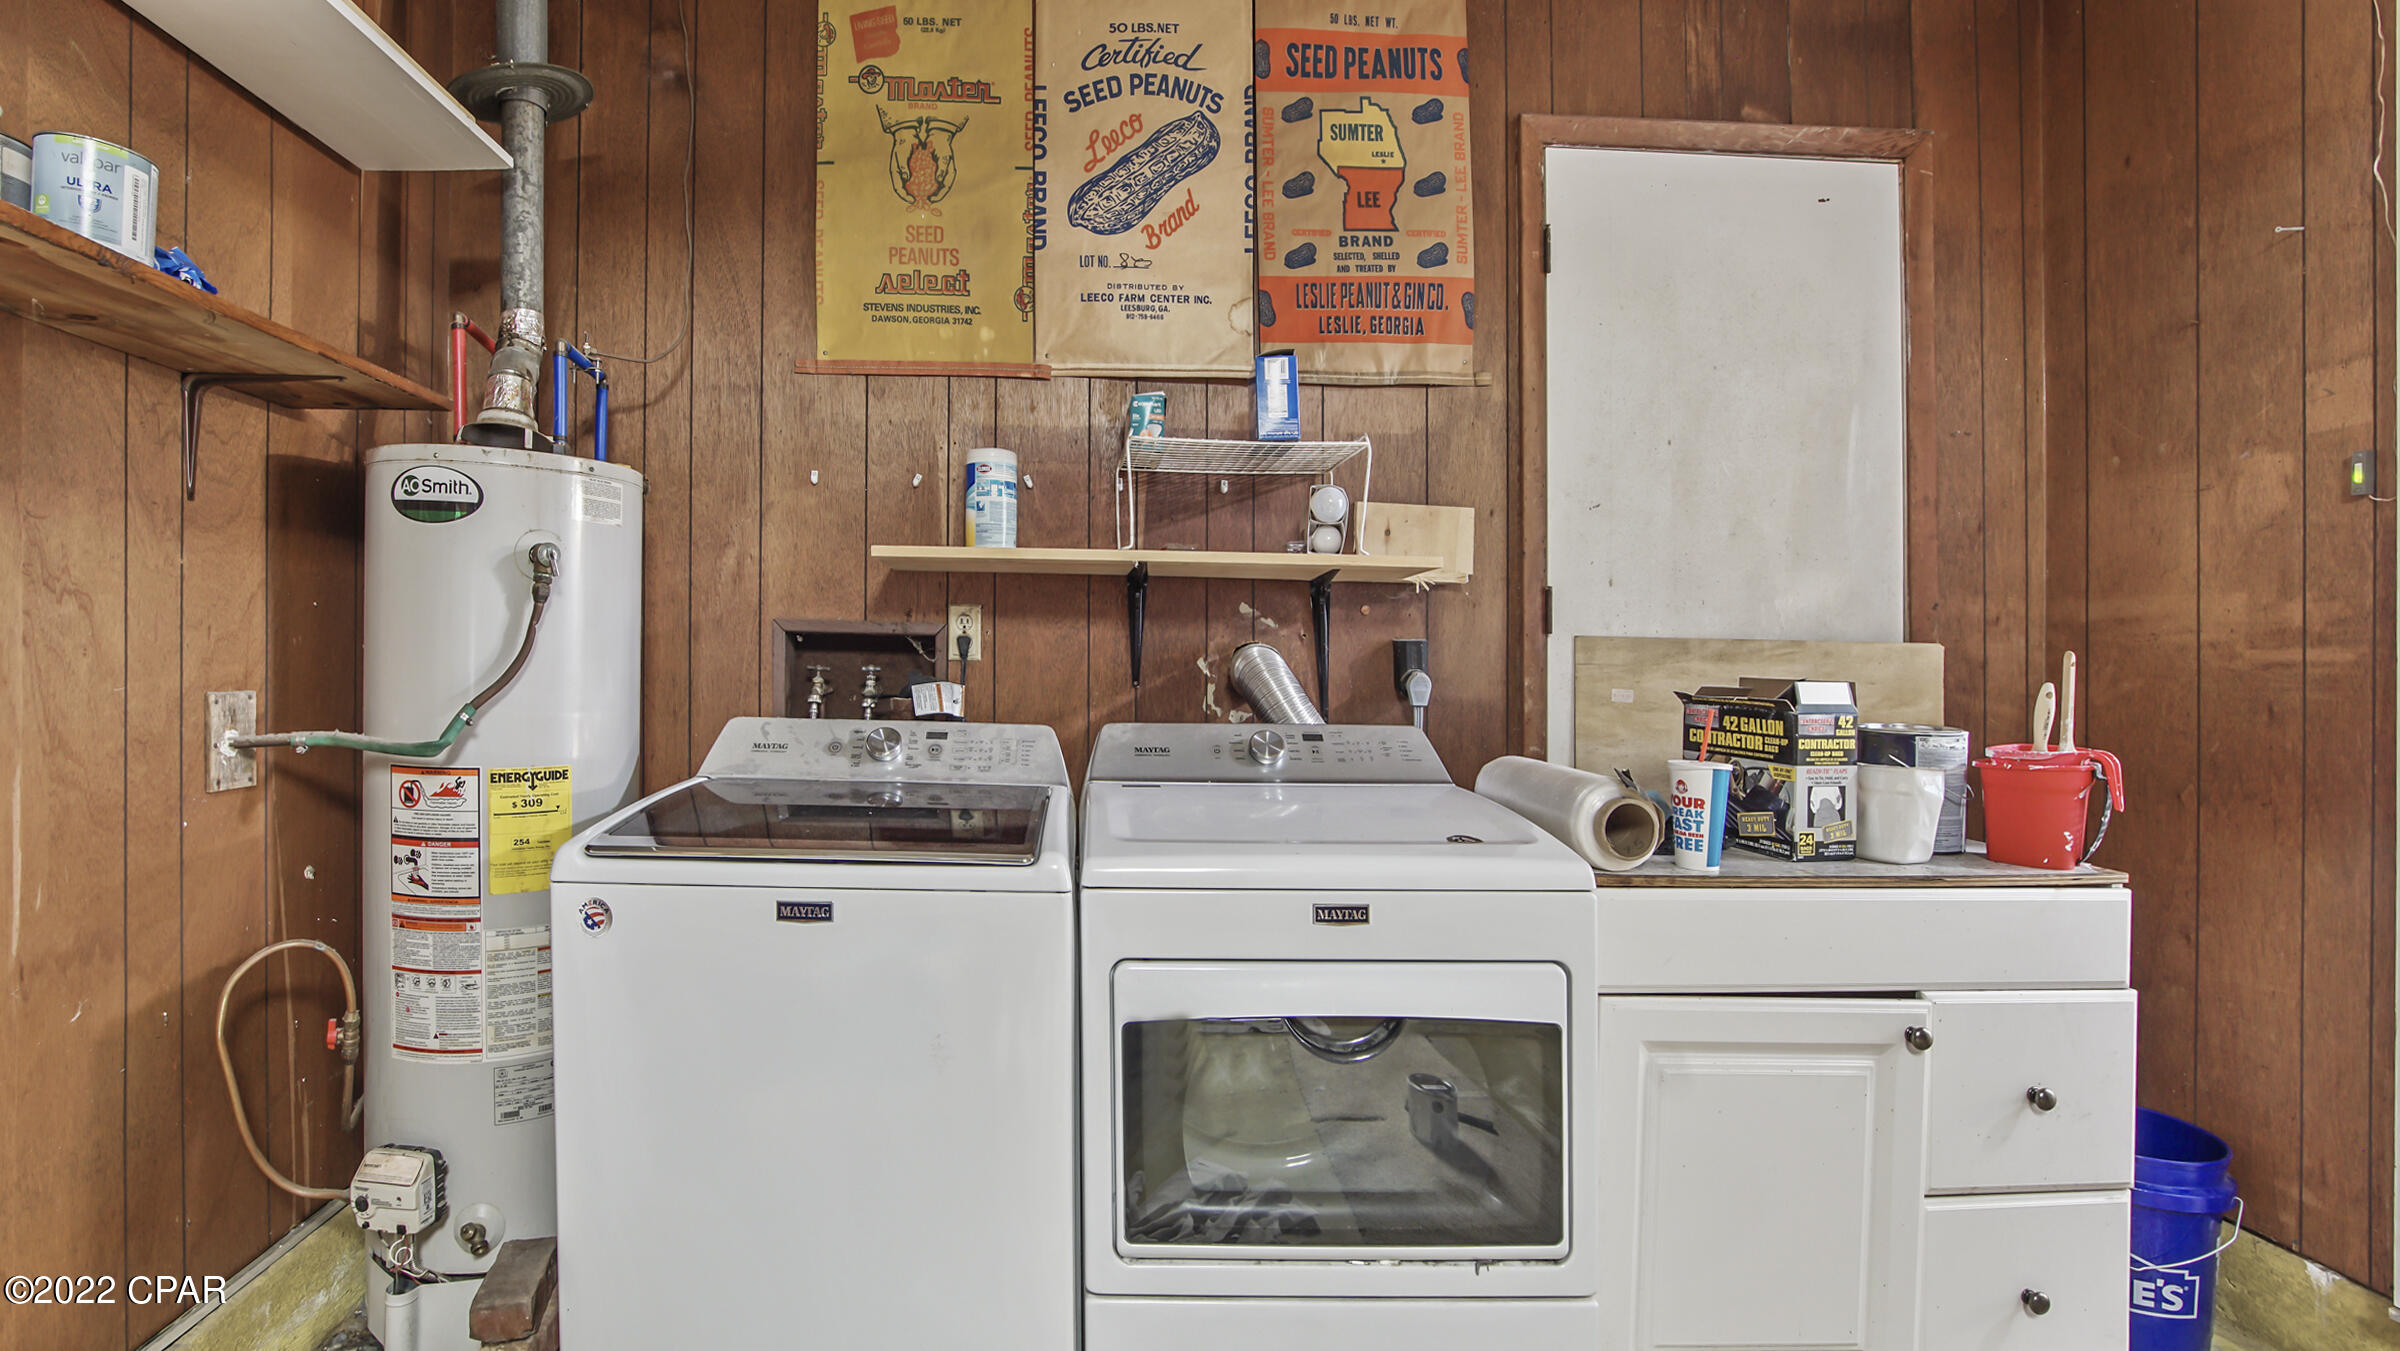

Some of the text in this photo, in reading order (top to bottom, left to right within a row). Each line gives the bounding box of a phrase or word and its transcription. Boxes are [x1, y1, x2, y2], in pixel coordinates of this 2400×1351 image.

[917, 17, 939, 26] LBS.
[943, 18, 962, 27] NET
[1109, 23, 1128, 33] 50
[1330, 13, 1398, 28] 50 LBS. NET WT.
[1081, 37, 1208, 71] Certified
[1285, 43, 1443, 81] SEED PEANUTS
[1063, 73, 1224, 114] SEED PEANUTS
[908, 102, 938, 110] BRAND
[1262, 107, 1275, 166] SUMTER
[1330, 124, 1384, 142] SUMTER
[1453, 112, 1467, 160] BRAND
[1083, 112, 1144, 173] Leeco
[1357, 191, 1382, 209] LEE
[1141, 188, 1200, 250] Brand
[905, 225, 944, 244] SEED
[1262, 212, 1276, 261] BRAND
[1338, 236, 1394, 248] BRAND
[1456, 206, 1469, 265] SUMTER
[889, 247, 960, 266] PEANUTS
[1080, 255, 1112, 268] LOT NO.
[1333, 252, 1400, 262] SELECTED, SHELLED
[1336, 264, 1396, 273] AND TREATED BY
[1107, 283, 1167, 291] DISTRIBUTED
[1080, 293, 1213, 304] LEECO FARM CENTER INC.
[1296, 283, 1337, 310] LESLIE
[1340, 282, 1389, 310] PEANUT
[1404, 283, 1425, 310] GIN
[1427, 284, 1449, 311] CO.
[863, 303, 904, 312] STEVENS
[906, 304, 963, 315] INDUSTRIES,
[871, 315, 973, 325] DAWSON, GEORGIA 31742
[1319, 315, 1425, 336] LESLIE, GEORGIA
[1722, 715, 1784, 736] 42 GALLON
[1838, 715, 1854, 728] 42
[1689, 728, 1763, 752] COTRACTOR
[1798, 739, 1856, 750] CONTRACTOR
[521, 798, 543, 808] 309
[1671, 794, 1705, 809] OUR
[1672, 807, 1704, 819] REAK
[1673, 817, 1704, 832] AST
[513, 838, 530, 846] 254
[1675, 836, 1703, 852] REE
[1800, 835, 1813, 845] 24
[780, 905, 831, 919] MAYTAG
[1316, 909, 1367, 921] MAYTAG
